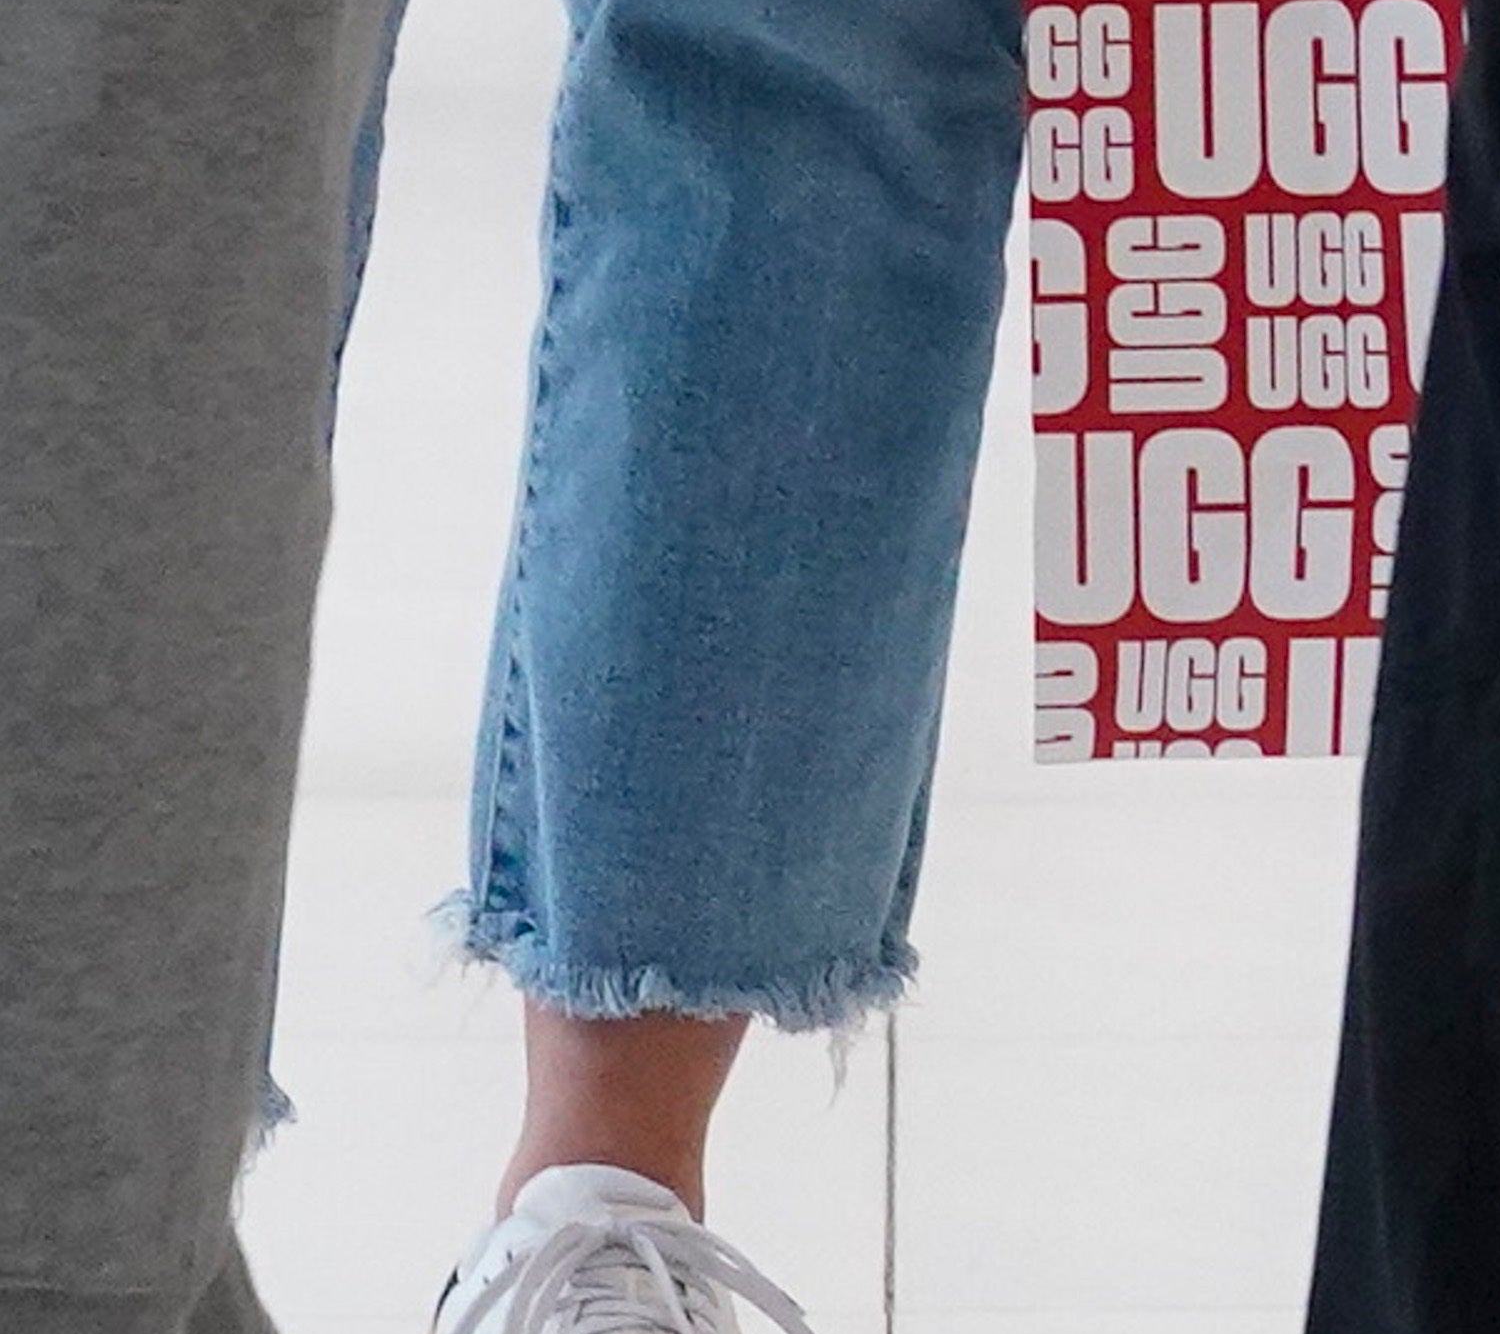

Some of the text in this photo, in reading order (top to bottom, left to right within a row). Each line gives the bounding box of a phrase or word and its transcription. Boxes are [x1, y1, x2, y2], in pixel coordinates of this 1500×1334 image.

[1026, 3, 1132, 99] GG
[1028, 105, 1135, 202] GG
[1242, 211, 1385, 307] UGG
[1105, 213, 1229, 414] UGG
[1246, 313, 1391, 410] UGG
[1034, 424, 1356, 627] UGG
[1115, 636, 1268, 732] UGG
